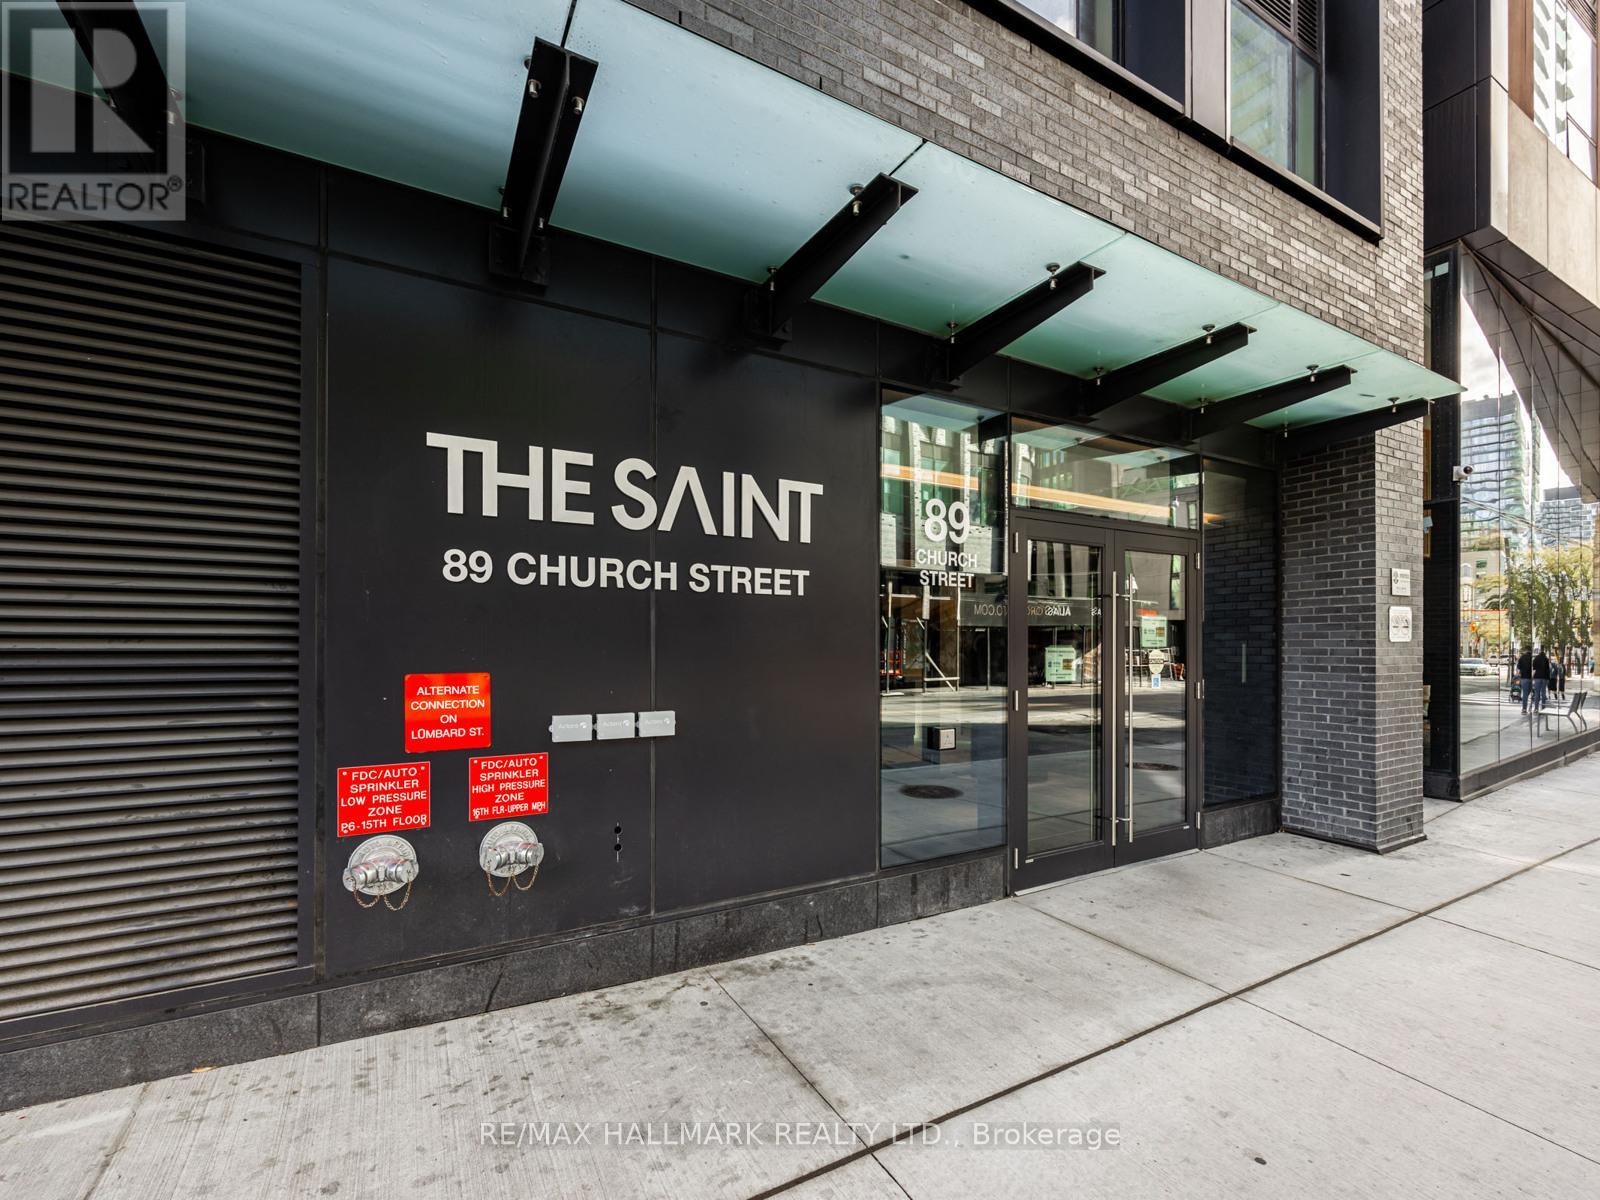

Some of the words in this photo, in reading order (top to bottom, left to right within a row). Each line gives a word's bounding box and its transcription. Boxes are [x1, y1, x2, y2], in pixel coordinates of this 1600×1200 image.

[426, 432, 594, 525] THE
[611, 457, 824, 544] SAINT
[924, 498, 971, 544] 89
[915, 548, 978, 568] CHURCH
[442, 548, 493, 584] 89
[506, 551, 678, 591] CHURCH
[688, 563, 810, 596] STREET
[919, 569, 975, 588] STREET
[417, 685, 480, 696] ALTERNATE
[410, 699, 485, 711] CONNECTION
[440, 714, 457, 724] ON
[411, 728, 466, 740] LOMBARD
[469, 727, 484, 737] ST.
[481, 757, 537, 770] FDC/AUTO
[352, 767, 417, 781] FDC/AUTO
[479, 769, 539, 782] SPRINKLER
[350, 779, 419, 794] SPRINKLER
[472, 784, 494, 794] HIGH
[499, 779, 545, 791] PRESSURE
[341, 796, 366, 807] LOW
[372, 790, 427, 804] PRESSURE
[495, 792, 525, 803] ZONE
[368, 804, 402, 817] ZONE
[392, 814, 427, 827] FLOOR
